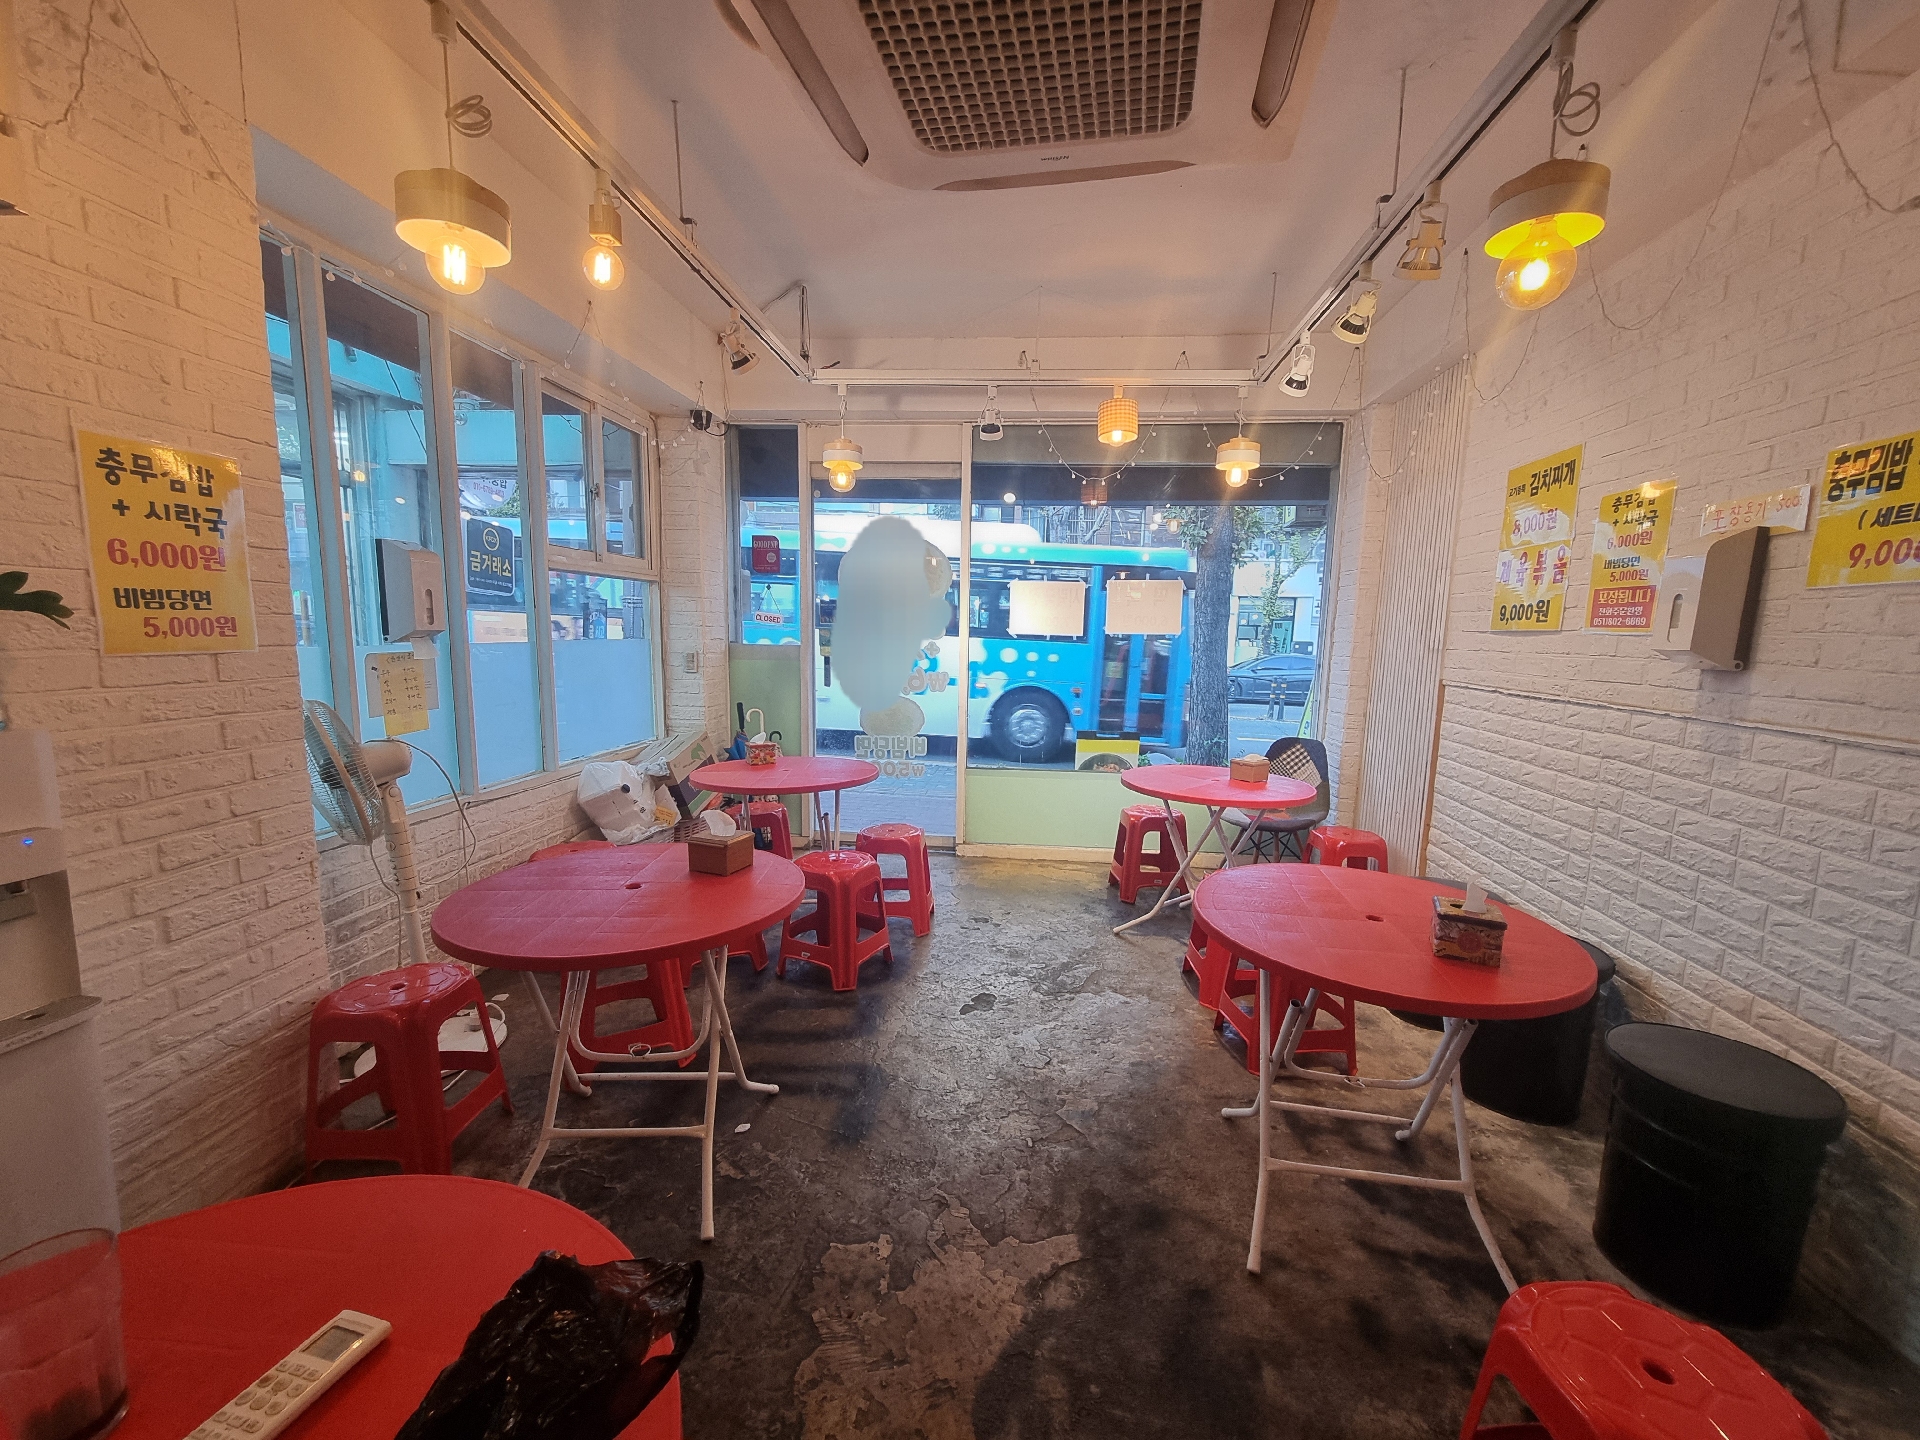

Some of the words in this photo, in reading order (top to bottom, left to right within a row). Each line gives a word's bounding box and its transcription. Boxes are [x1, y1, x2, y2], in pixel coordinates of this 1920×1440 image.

[1529, 458, 1577, 498] 김치찌개
[143, 500, 228, 540] 시락국
[1858, 502, 1920, 530] (세트
[107, 537, 228, 572] 6,000원
[469, 550, 512, 577] 금거래소
[1603, 555, 1641, 570] 비빔당면
[1609, 568, 1650, 583] 5,000원
[112, 586, 213, 611] 비빔당면
[1597, 588, 1652, 605] 포장됩니다
[755, 613, 781, 624] CLOSED
[1499, 599, 1551, 626] 9,000원
[142, 615, 239, 640] 5,000원
